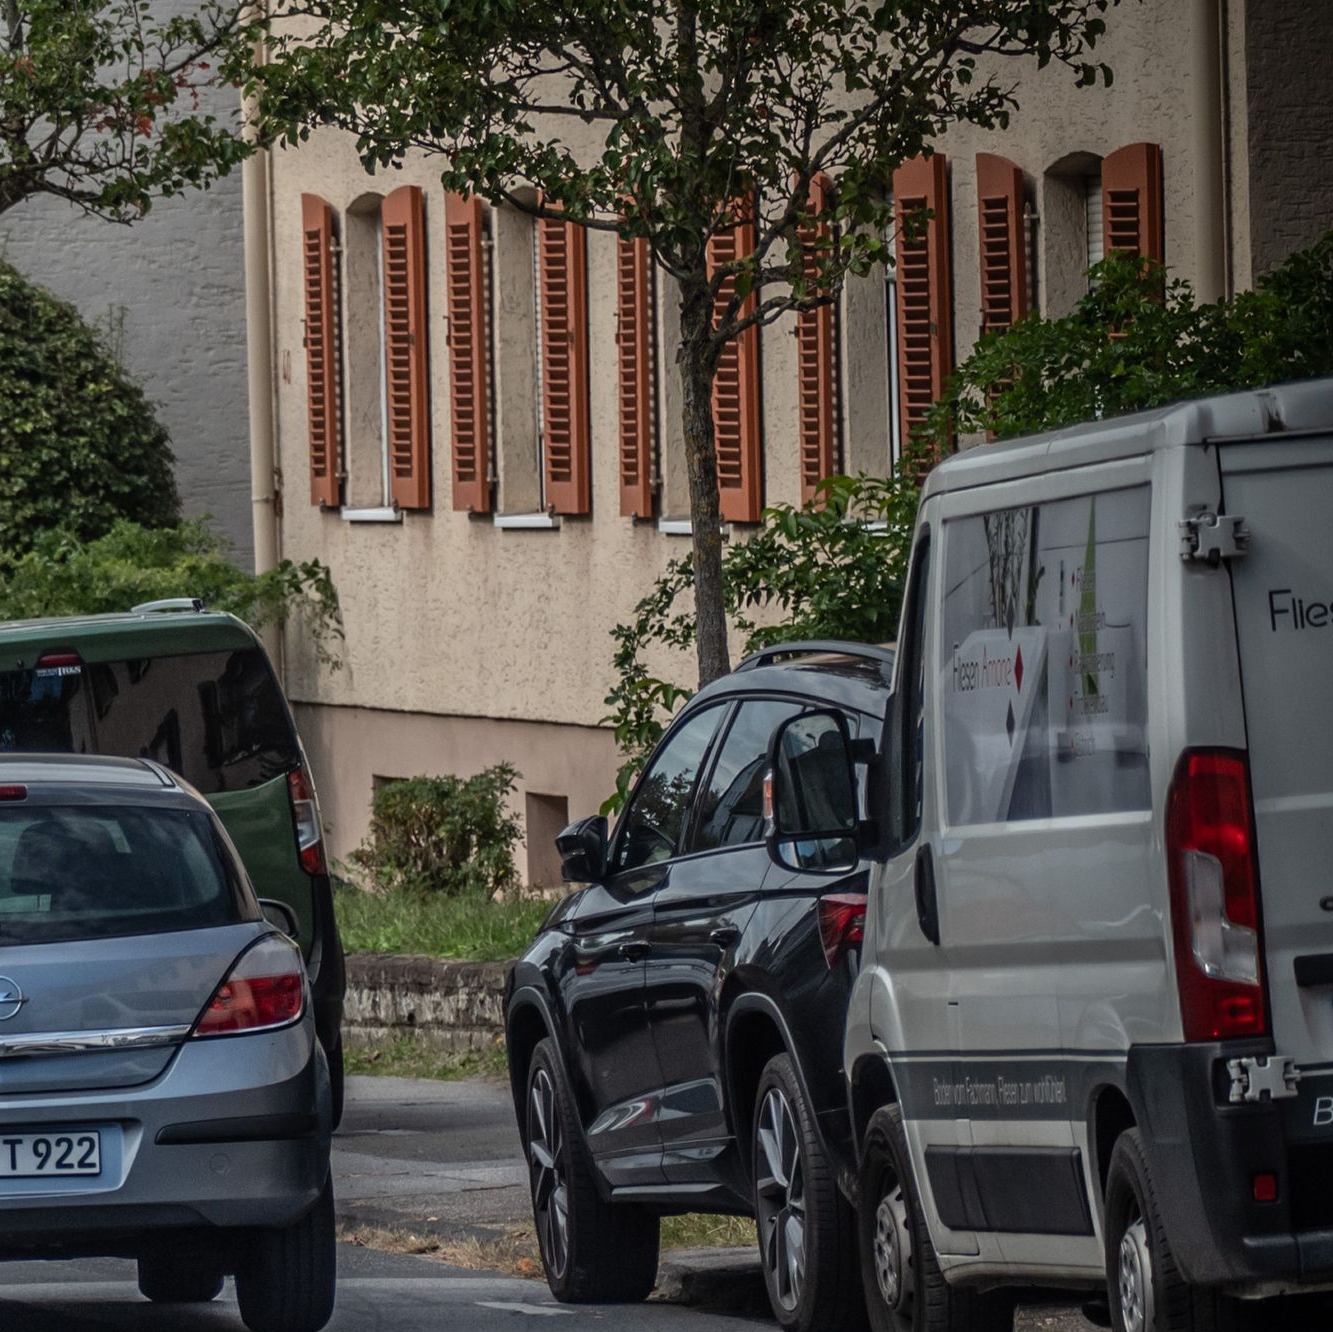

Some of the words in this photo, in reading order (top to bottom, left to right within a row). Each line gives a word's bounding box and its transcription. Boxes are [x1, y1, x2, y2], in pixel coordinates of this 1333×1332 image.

[1268, 588, 1333, 632] Flie
[2, 1139, 23, 1170] T
[33, 1136, 97, 1170] 922
